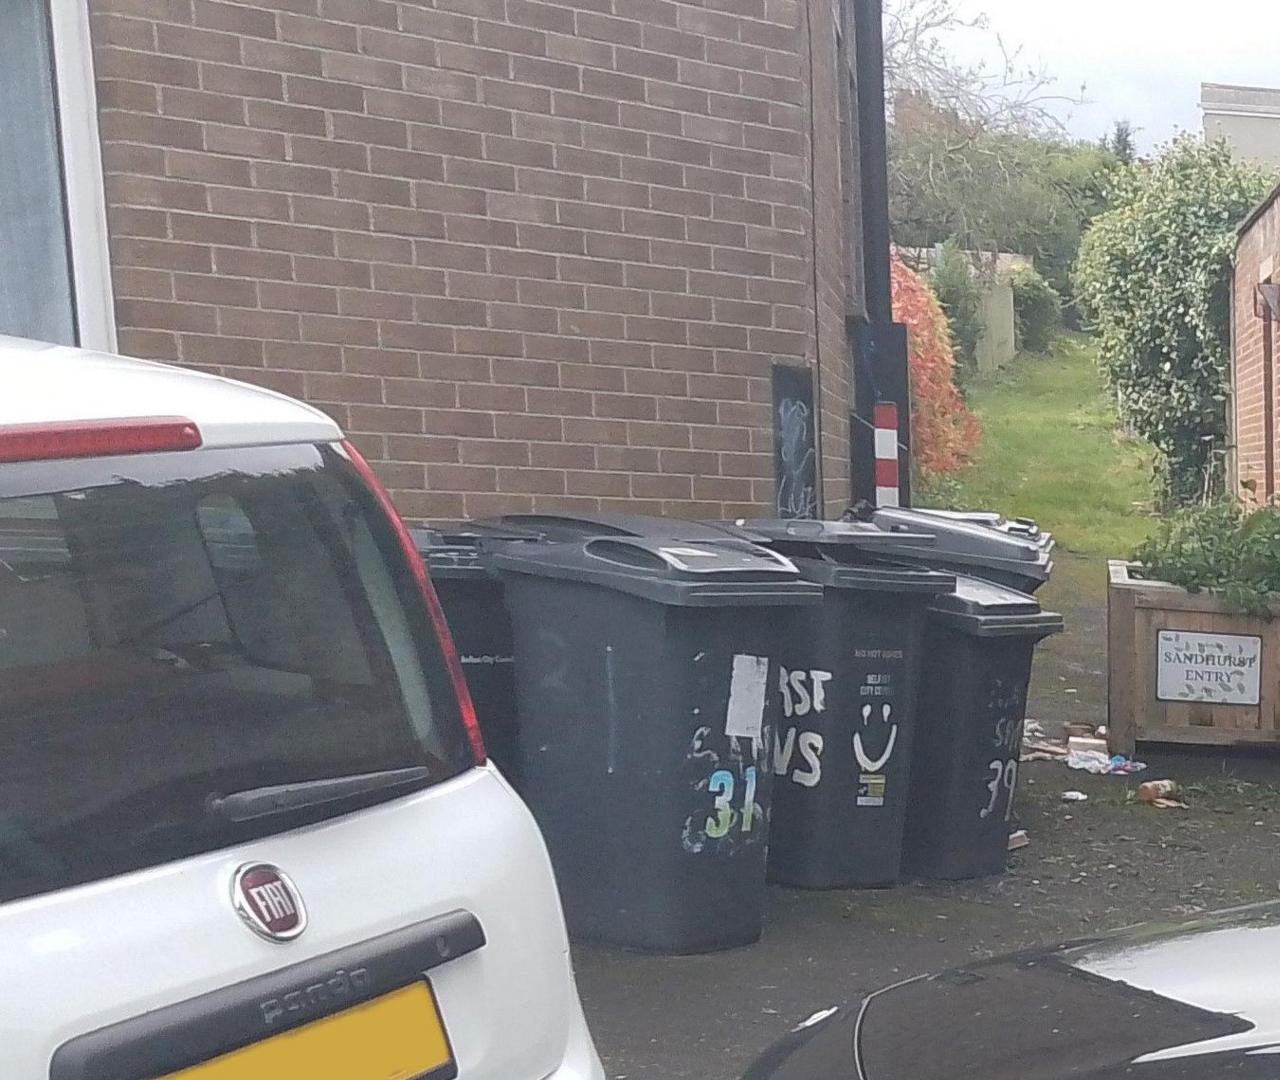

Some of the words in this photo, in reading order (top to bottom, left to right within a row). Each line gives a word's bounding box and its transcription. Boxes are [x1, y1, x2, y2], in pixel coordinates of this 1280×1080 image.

[1163, 650, 1257, 668] SANDHURST
[1184, 669, 1232, 683] ENTRY
[705, 766, 756, 838] 31
[247, 880, 296, 922] FIAT
